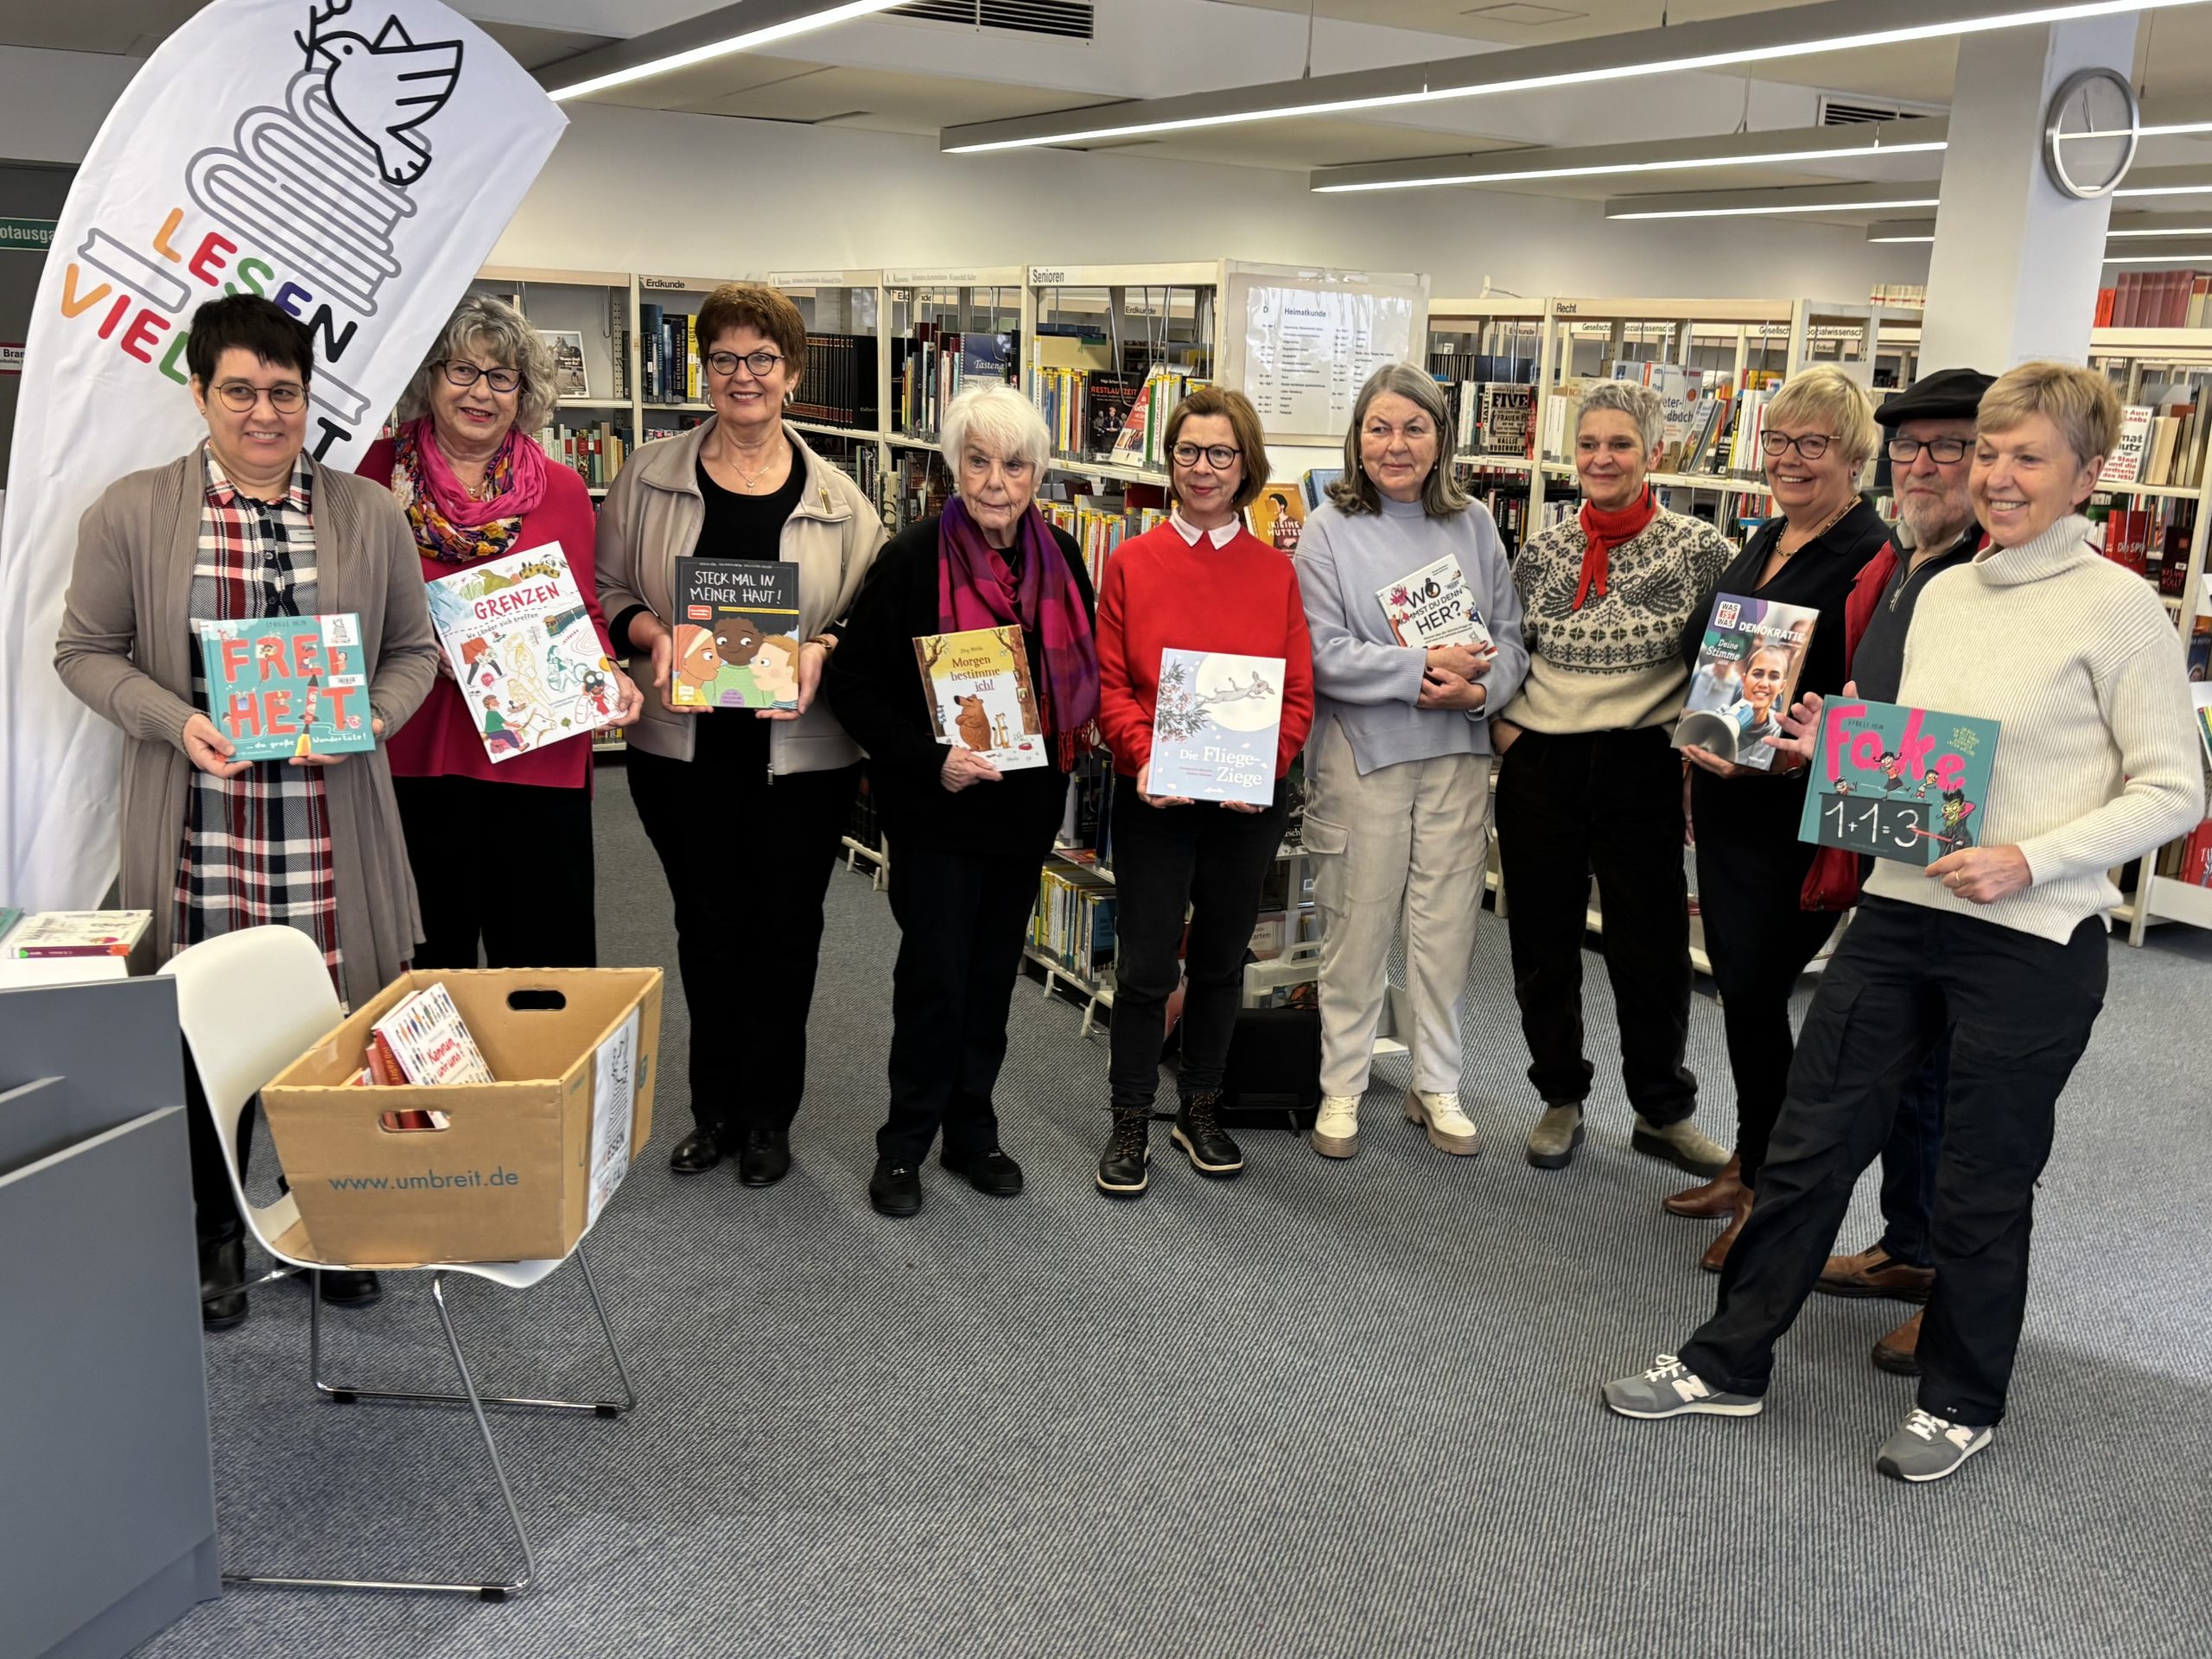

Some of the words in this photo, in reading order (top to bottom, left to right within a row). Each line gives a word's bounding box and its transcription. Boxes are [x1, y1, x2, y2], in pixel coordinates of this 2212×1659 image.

[0, 226, 56, 243] otausga
[1033, 269, 1065, 283] Senioren
[153, 207, 358, 363] LESEN
[645, 278, 685, 289] Erdkunde
[1284, 307, 1326, 318] Heimatkunde
[1556, 302, 1576, 314] Recht
[1582, 323, 1611, 332] Gesellscha
[974, 359, 1005, 372] Tasteng
[1091, 386, 1138, 396] RESTLAUZEIT
[1492, 393, 1529, 407] FIVE
[1662, 397, 1682, 408] eter-
[1665, 410, 1694, 423] dbuch
[695, 570, 729, 586] STECK
[732, 574, 757, 587] MAL
[760, 575, 775, 587] IN
[474, 582, 560, 620] GRENZEN
[690, 587, 736, 603] MEINER
[742, 588, 782, 604] HAUT!
[1405, 582, 1441, 608] WO
[1428, 601, 1441, 611] DU
[1440, 588, 1463, 603] DENN
[1721, 603, 1738, 612] WAS
[499, 617, 513, 628] sich
[514, 611, 538, 625] treffen
[1415, 601, 1462, 635] HER?
[1717, 619, 1734, 627] WAS
[1738, 622, 1805, 642] DEMOKRATIE
[1718, 639, 1738, 650] Deine
[221, 634, 340, 683] FREI
[1706, 645, 1741, 661] Stimme
[951, 656, 991, 668] Morgen
[950, 668, 1001, 682] bestimme
[975, 680, 995, 692] ich!
[270, 740, 296, 750] große
[1826, 704, 1967, 791] Fake
[1179, 748, 1199, 760] Die
[1202, 747, 1262, 768] Fliege-
[1216, 766, 1262, 788] Ziege
[1254, 931, 1271, 941] arten
[328, 1166, 518, 1192] www.umbreit.de
[1672, 1376, 1710, 1402] N
